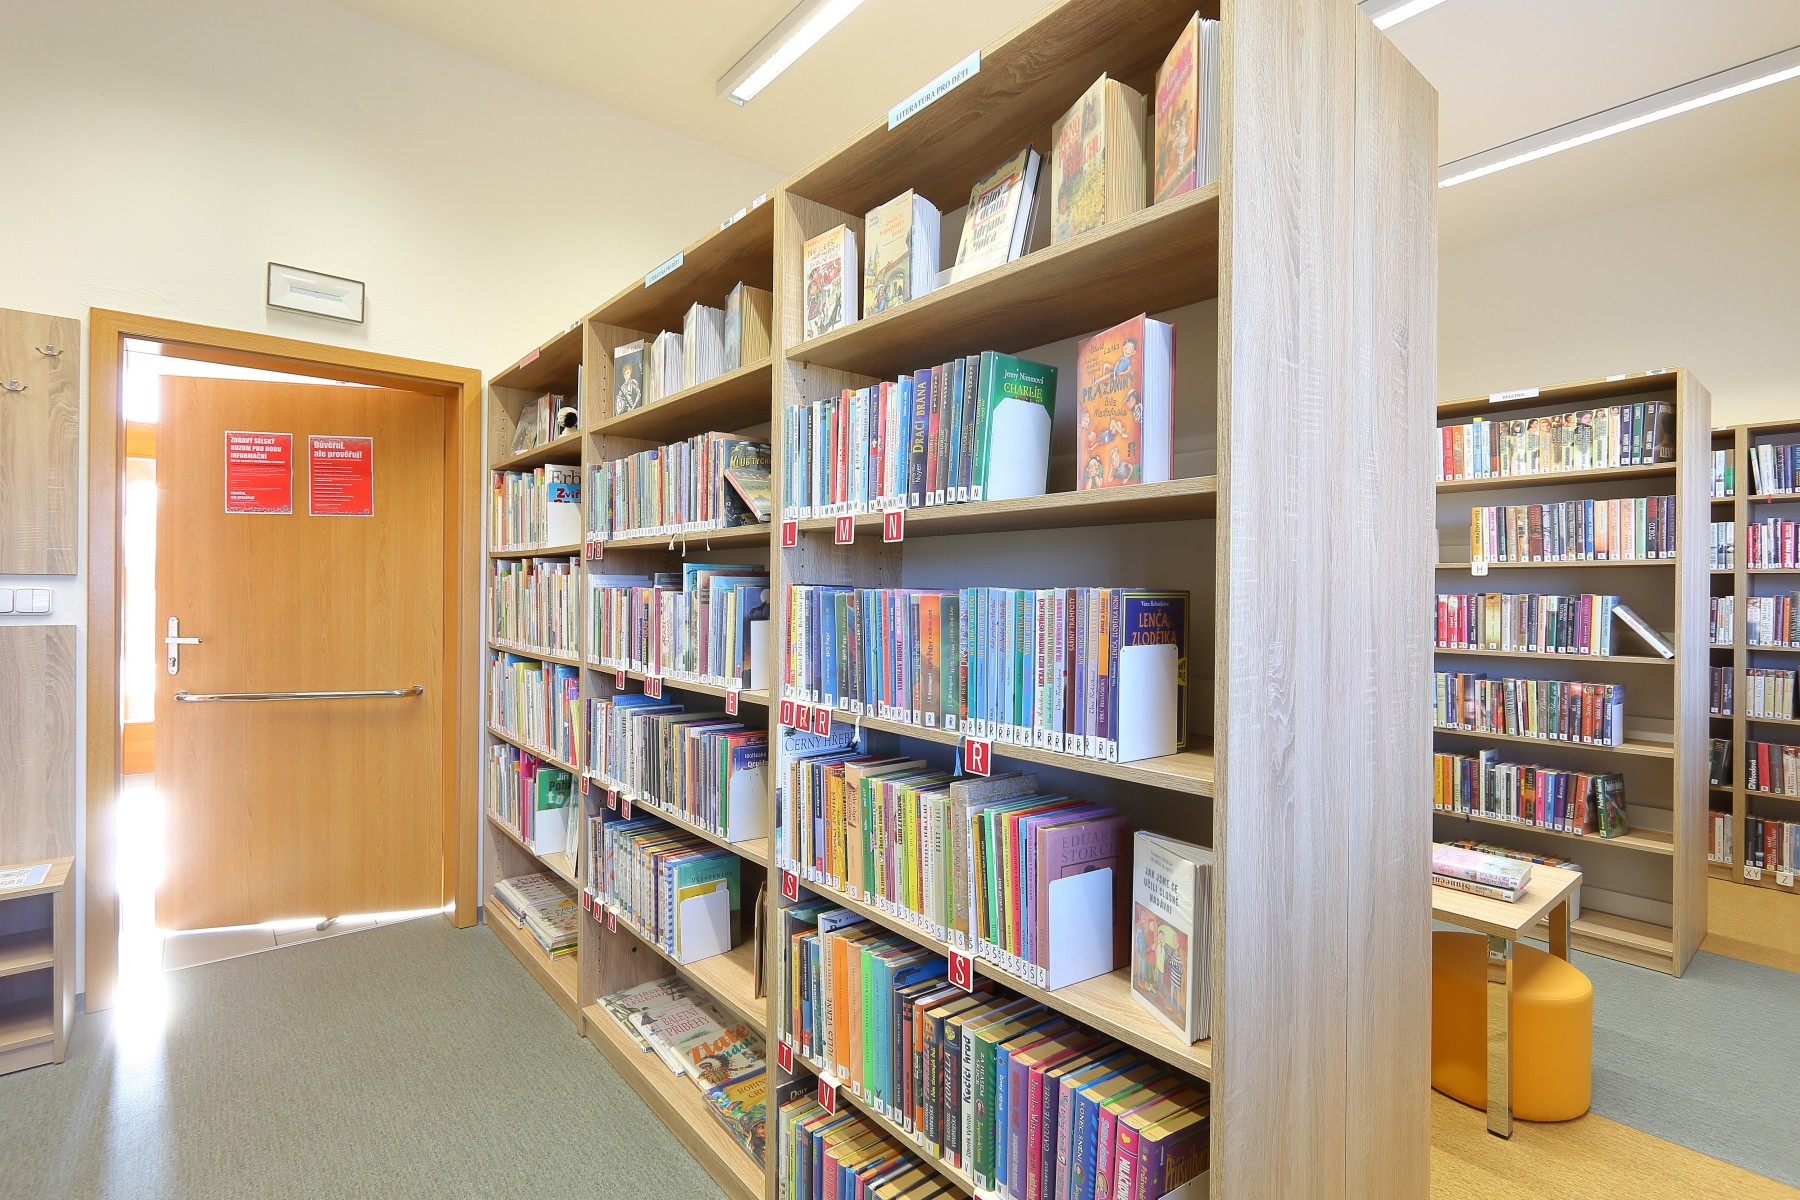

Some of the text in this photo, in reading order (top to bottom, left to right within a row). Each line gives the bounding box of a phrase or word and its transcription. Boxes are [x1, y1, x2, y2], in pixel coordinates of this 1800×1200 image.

[896, 68, 969, 121] LITERATURA PRO DĚTI
[972, 213, 1006, 241] Adriana
[1090, 342, 1104, 354] David
[1004, 370, 1019, 380] Jenny
[1004, 382, 1043, 399] CHARLIE
[912, 382, 927, 454] DRAČÍ BRÁNA
[328, 451, 363, 459] prověřuj!
[730, 456, 751, 468] KLUB
[786, 524, 792, 544] L
[840, 519, 849, 541] M
[890, 514, 898, 538] N
[588, 546, 592, 557] A
[1477, 565, 1483, 574] H
[1139, 610, 1171, 629] LENČA,
[654, 681, 659, 694] D
[730, 691, 734, 712] E
[784, 703, 791, 724] O
[819, 712, 826, 734] R
[971, 743, 983, 772] Ř
[1062, 828, 1119, 850] EDUARD
[1061, 842, 1119, 864] ŠTORCH
[1144, 867, 1178, 893] JAK JSME SE
[1746, 869, 1760, 879] X Y
[1782, 876, 1788, 885] Z
[787, 875, 794, 896] S
[1144, 876, 1179, 907] UČILI SLUŠNĚ
[1150, 893, 1173, 916] NADÁVAT
[610, 915, 614, 929] K
[956, 954, 965, 985] Š
[662, 1006, 699, 1026] BALETNÍ
[686, 1023, 750, 1066] Zlaté
[721, 1035, 759, 1060] údolí
[782, 1045, 789, 1067] T
[963, 1035, 971, 1104] Kočičí hrad
[790, 1087, 808, 1100] DOLY
[823, 1083, 830, 1108] V
[1030, 1114, 1039, 1149] Wilsonová
